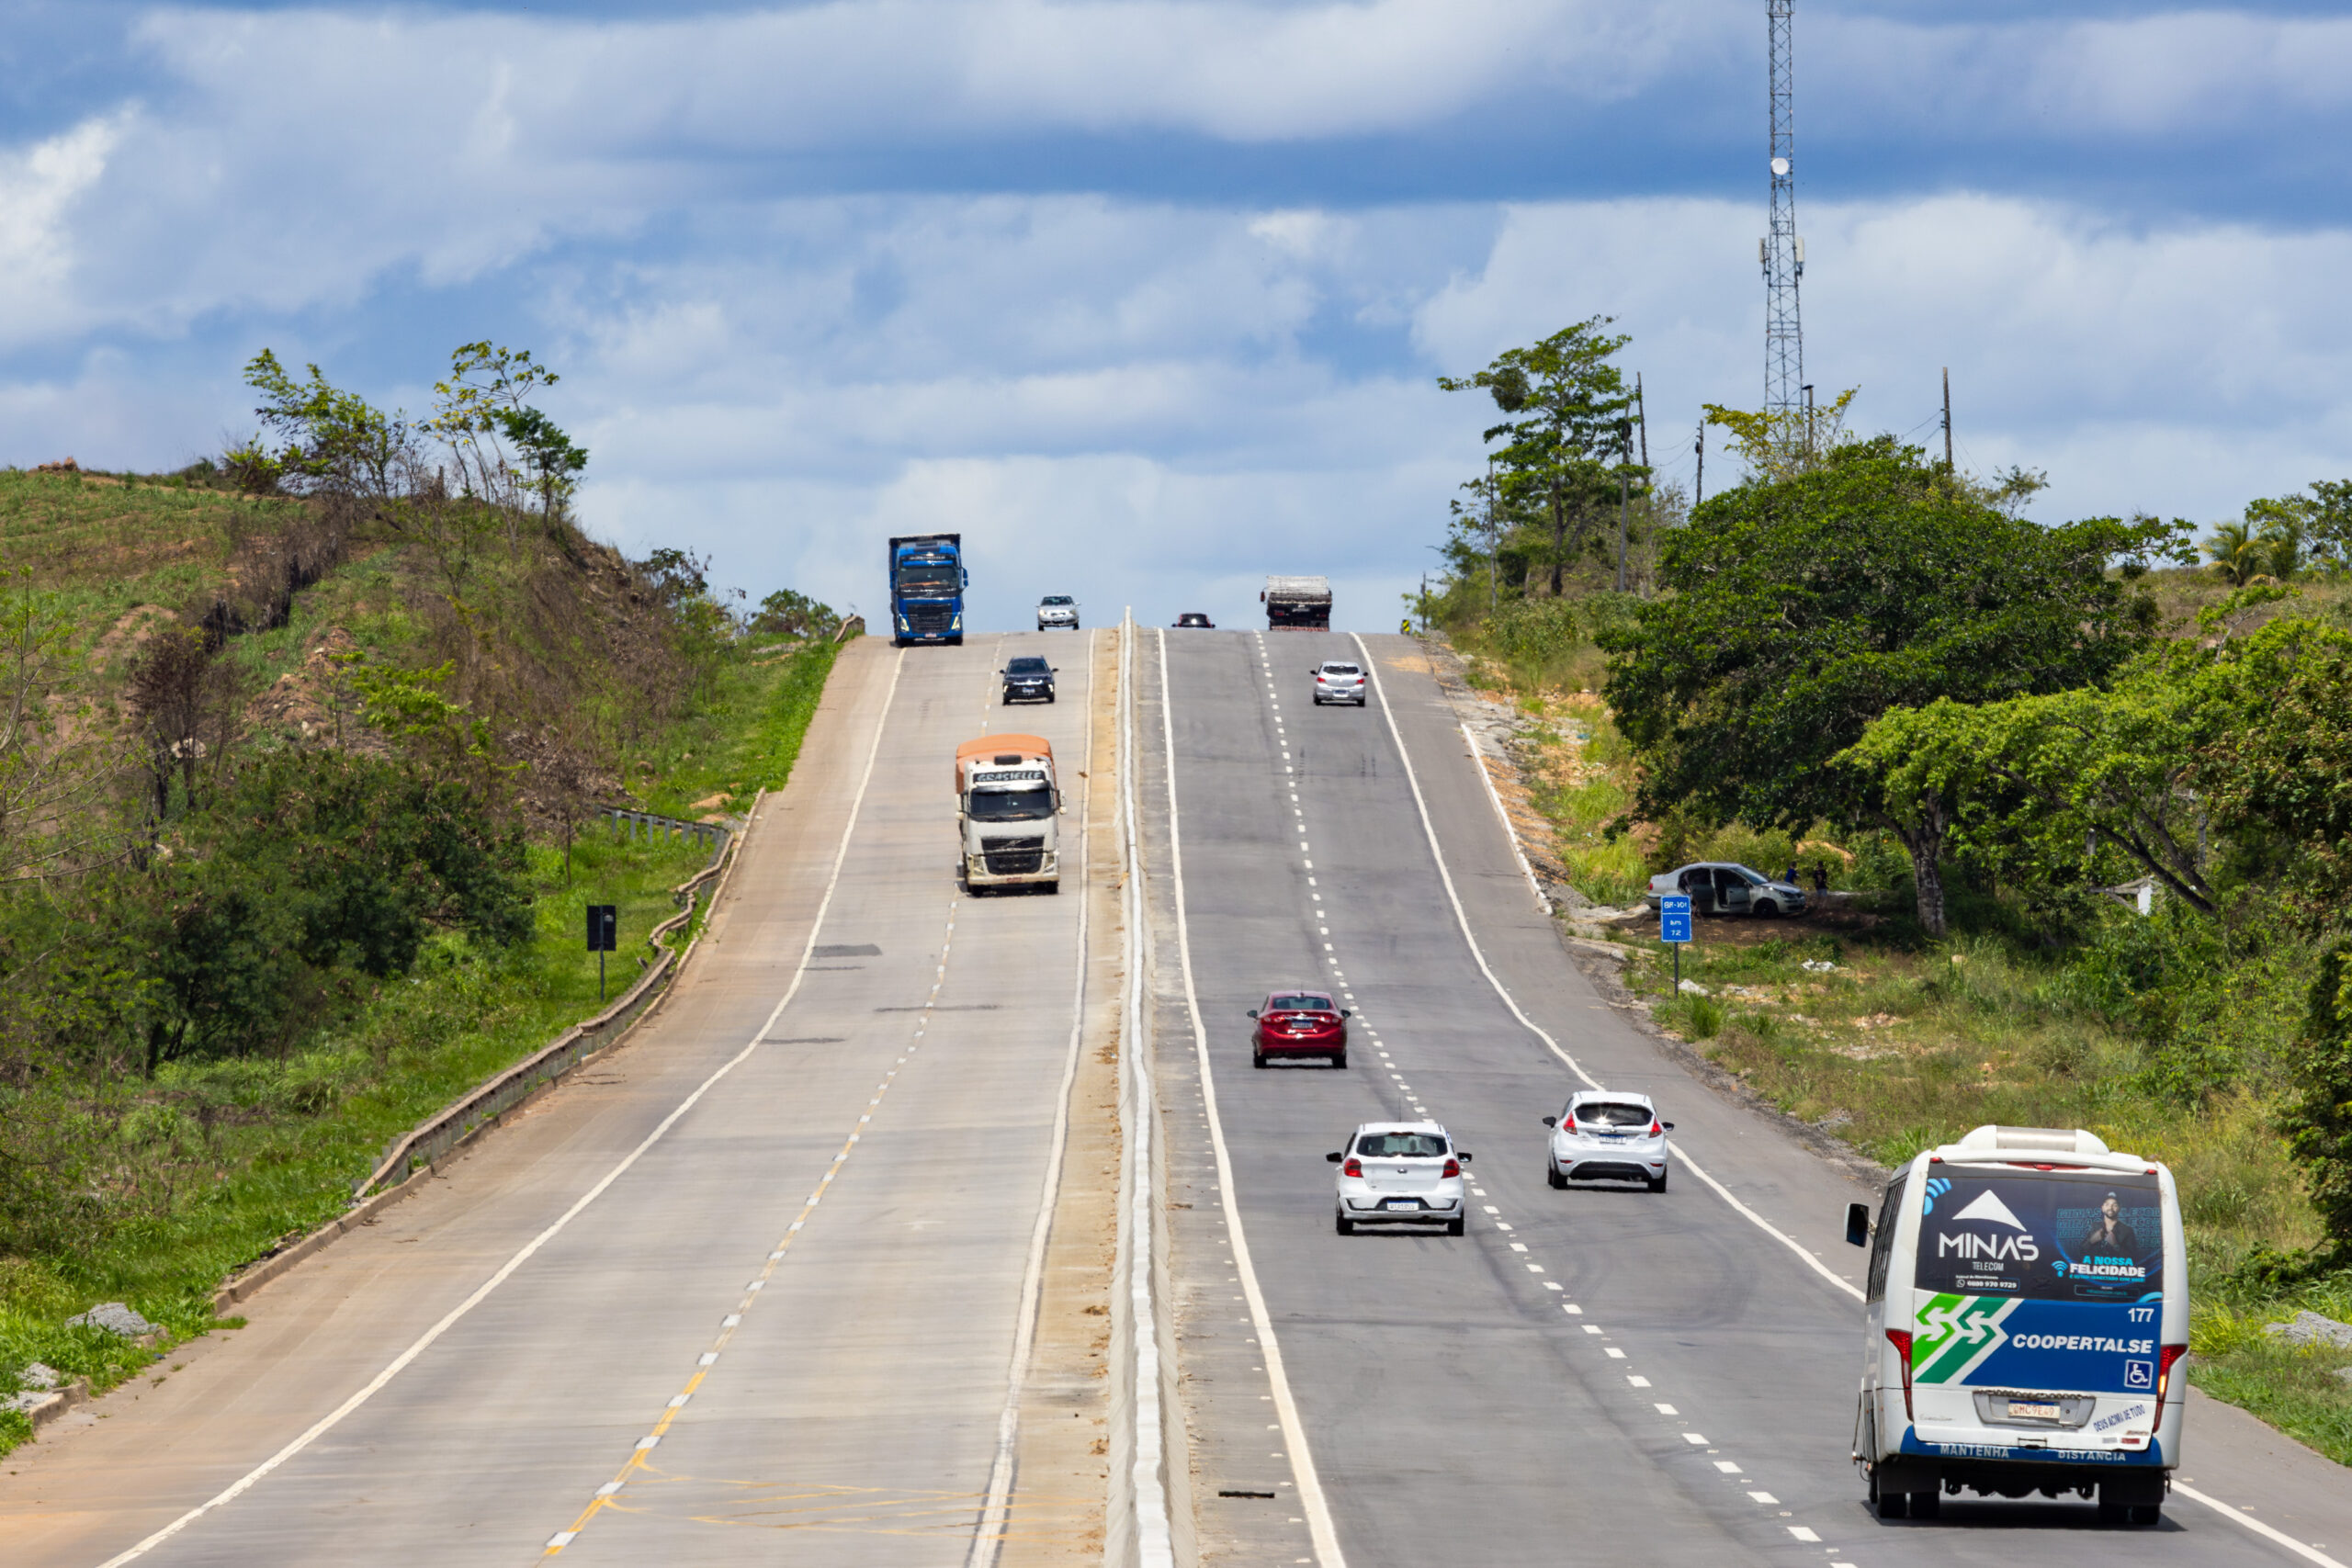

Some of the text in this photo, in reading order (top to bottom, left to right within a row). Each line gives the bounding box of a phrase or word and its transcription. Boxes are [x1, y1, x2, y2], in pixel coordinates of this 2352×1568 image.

[1939, 1232, 2039, 1261] MINAS
[1972, 1261, 2004, 1271] TELECOM
[2083, 1255, 2133, 1266] A NOSSA
[2069, 1263, 2145, 1278] FELICIDADE
[2128, 1308, 2154, 1323] 177
[2012, 1334, 2154, 1354] COOPERTALSE
[1939, 1445, 2010, 1459] MANTENHA
